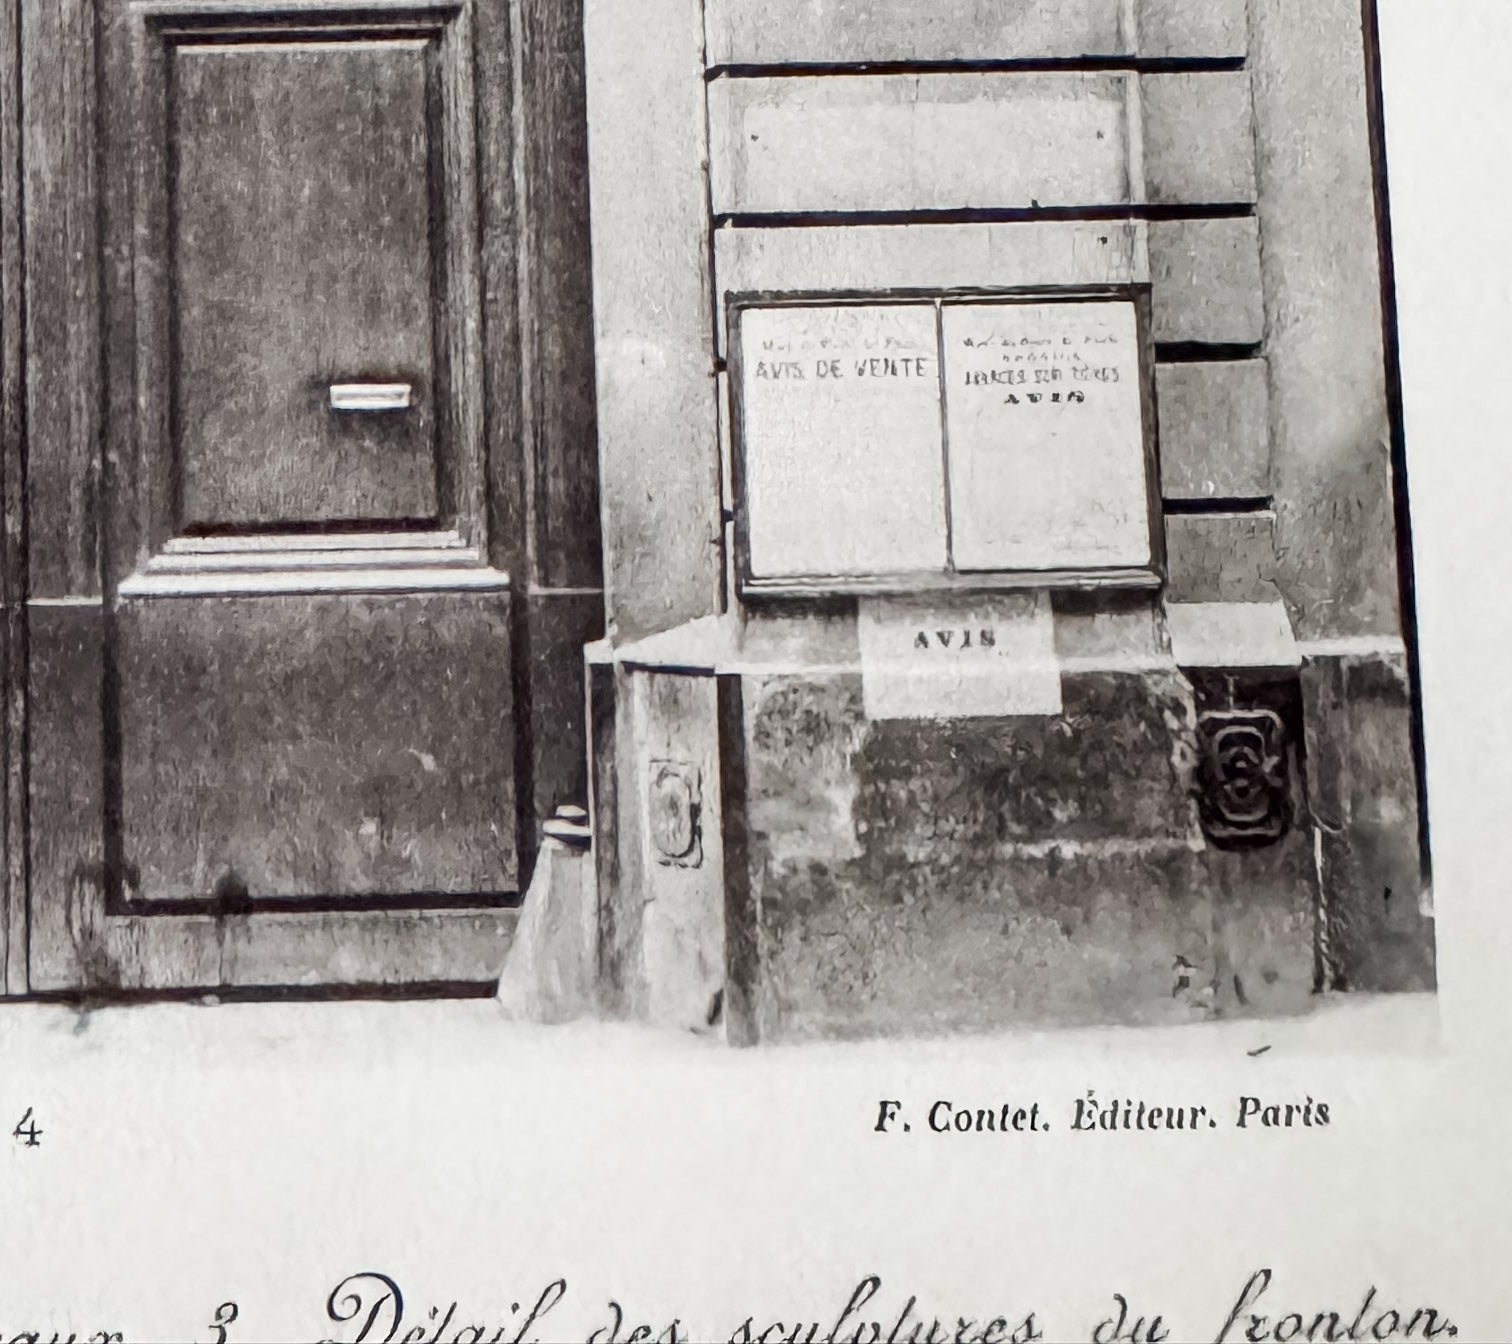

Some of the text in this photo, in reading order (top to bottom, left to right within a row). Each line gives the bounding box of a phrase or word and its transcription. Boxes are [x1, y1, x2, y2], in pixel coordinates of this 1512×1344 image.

[816, 359, 843, 378] DE
[913, 628, 996, 650] AVIS
[11, 1106, 44, 1148] 4
[873, 1100, 911, 1133] F.
[1236, 1095, 1331, 1129] Paris
[1090, 1293, 1171, 1344] du
